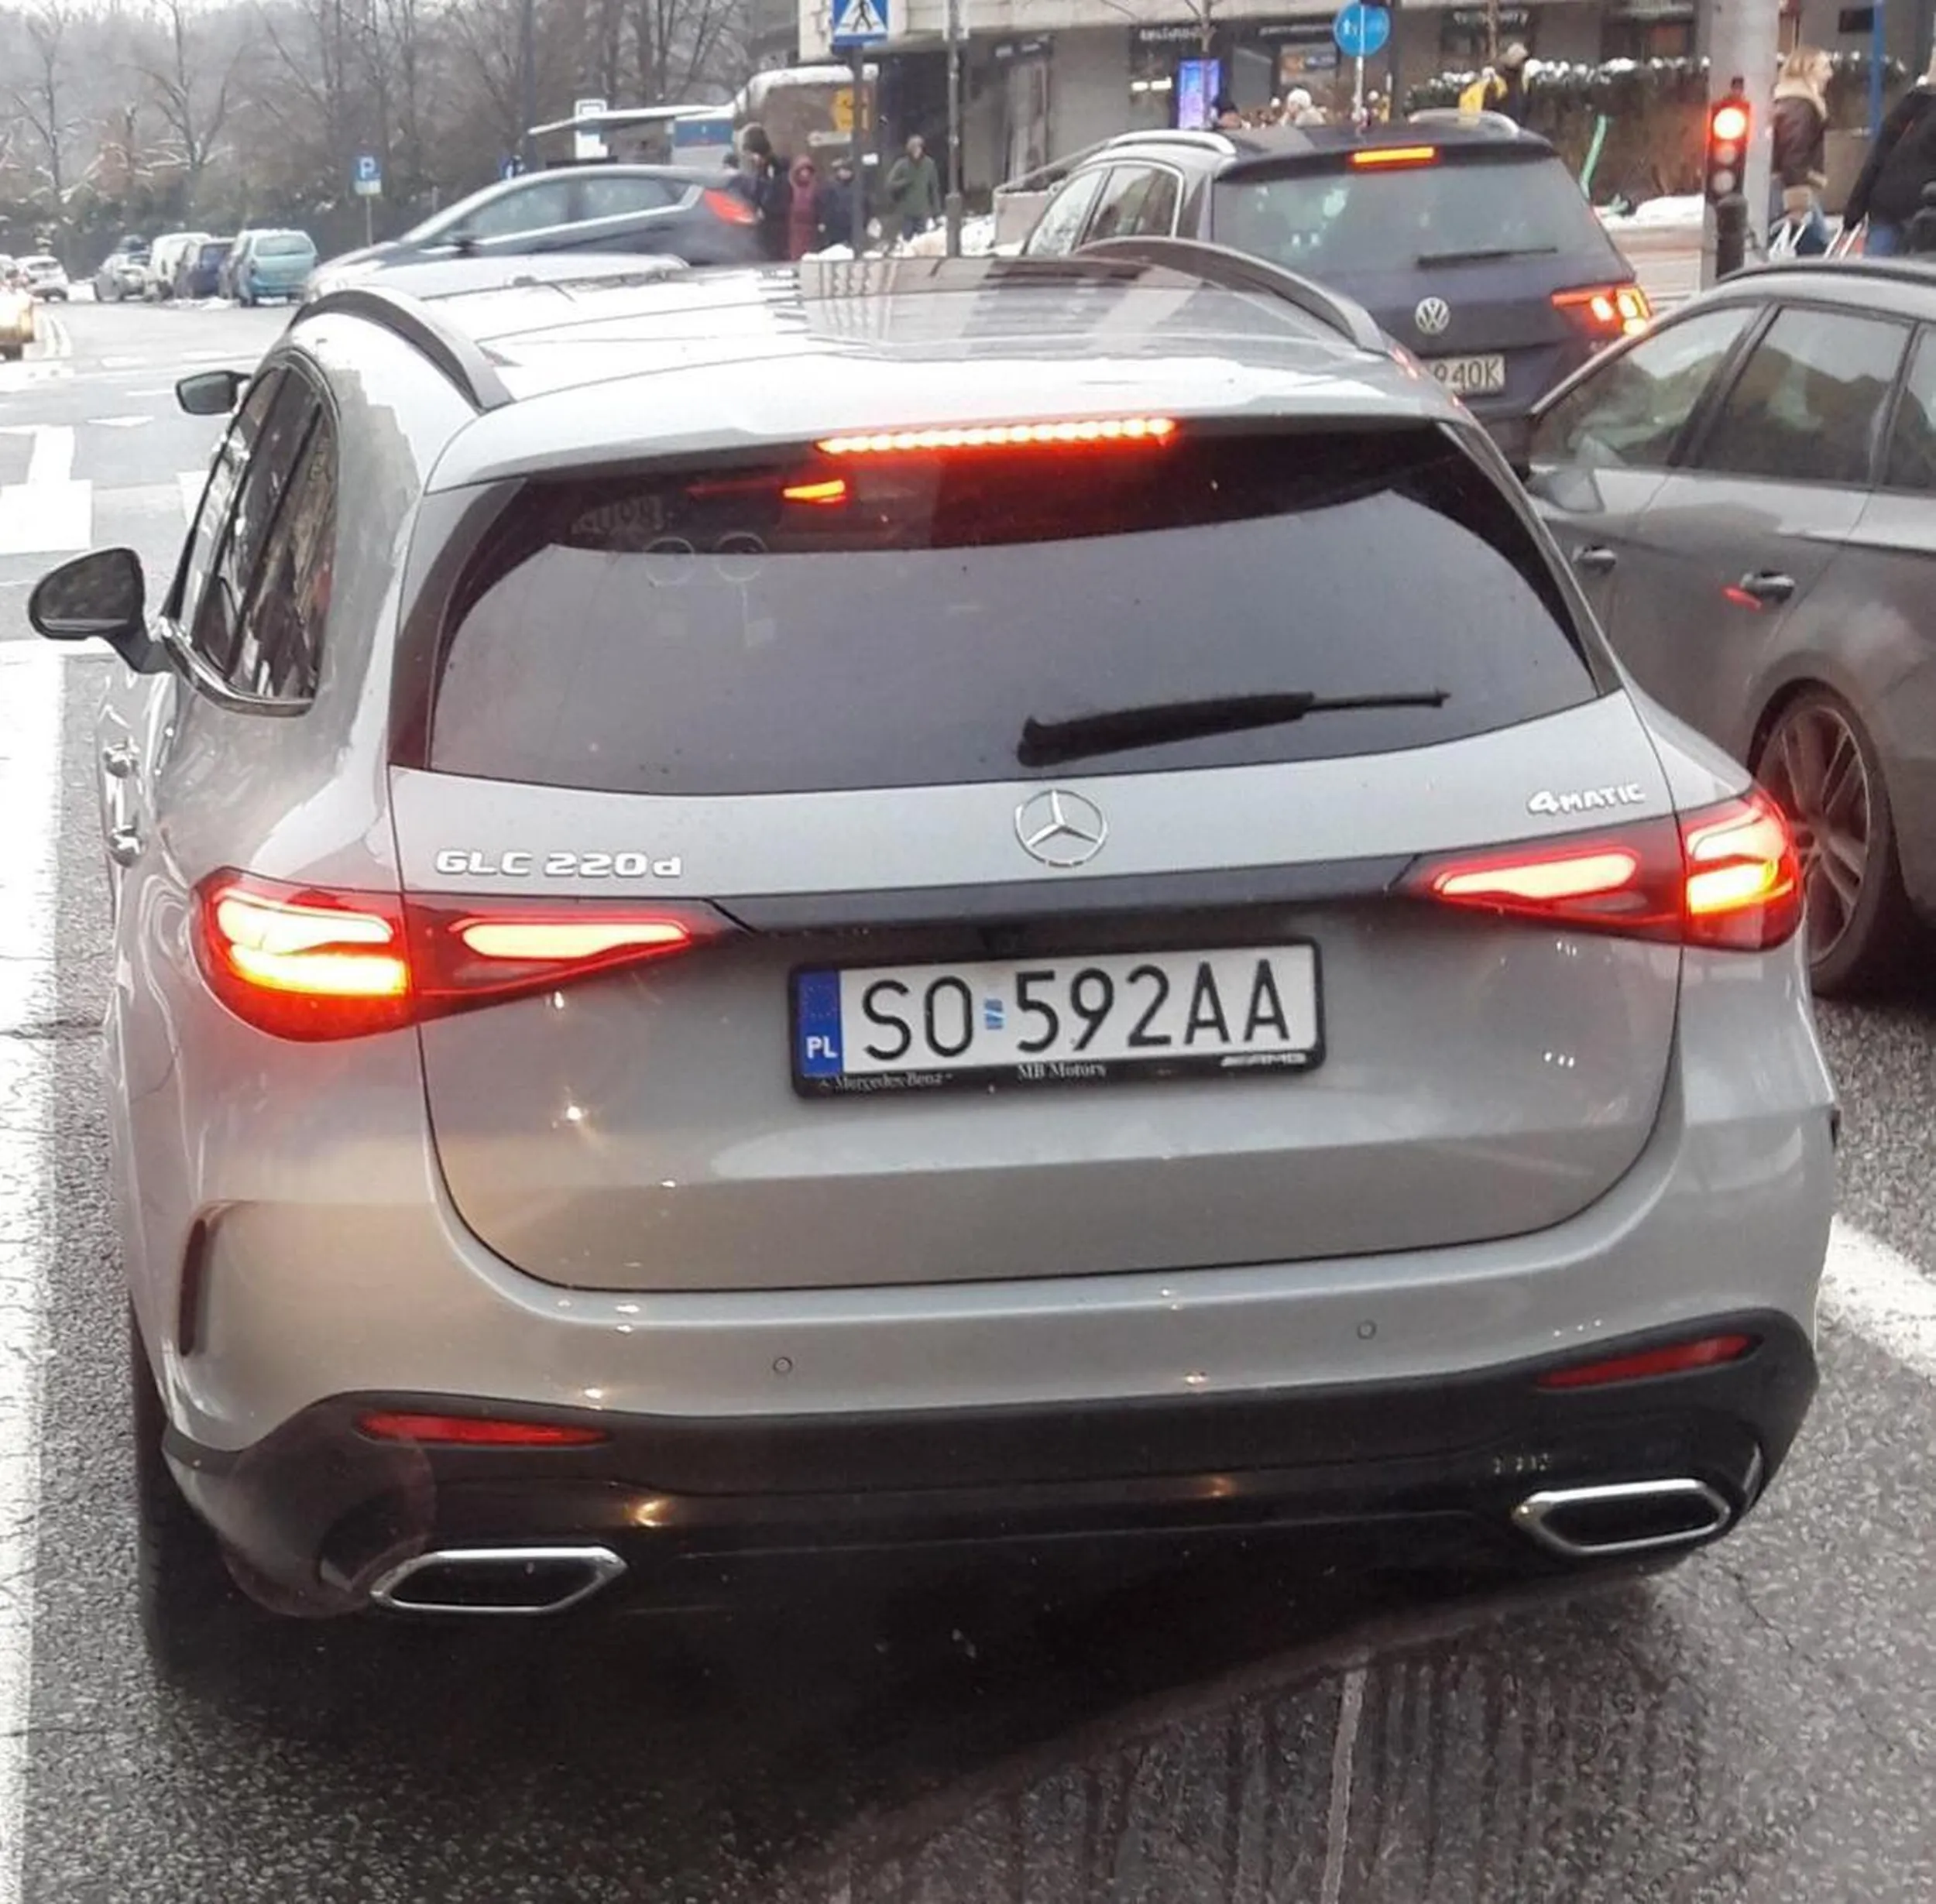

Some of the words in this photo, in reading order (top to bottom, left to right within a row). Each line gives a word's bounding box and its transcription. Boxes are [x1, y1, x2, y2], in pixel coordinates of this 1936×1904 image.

[360, 157, 376, 178] P
[1528, 783, 1646, 815] 4MATIC
[437, 850, 532, 875] GLC
[544, 852, 681, 877] 220d
[862, 976, 973, 1061] SO
[1015, 959, 1290, 1053] 592AA
[807, 1035, 838, 1058] PL
